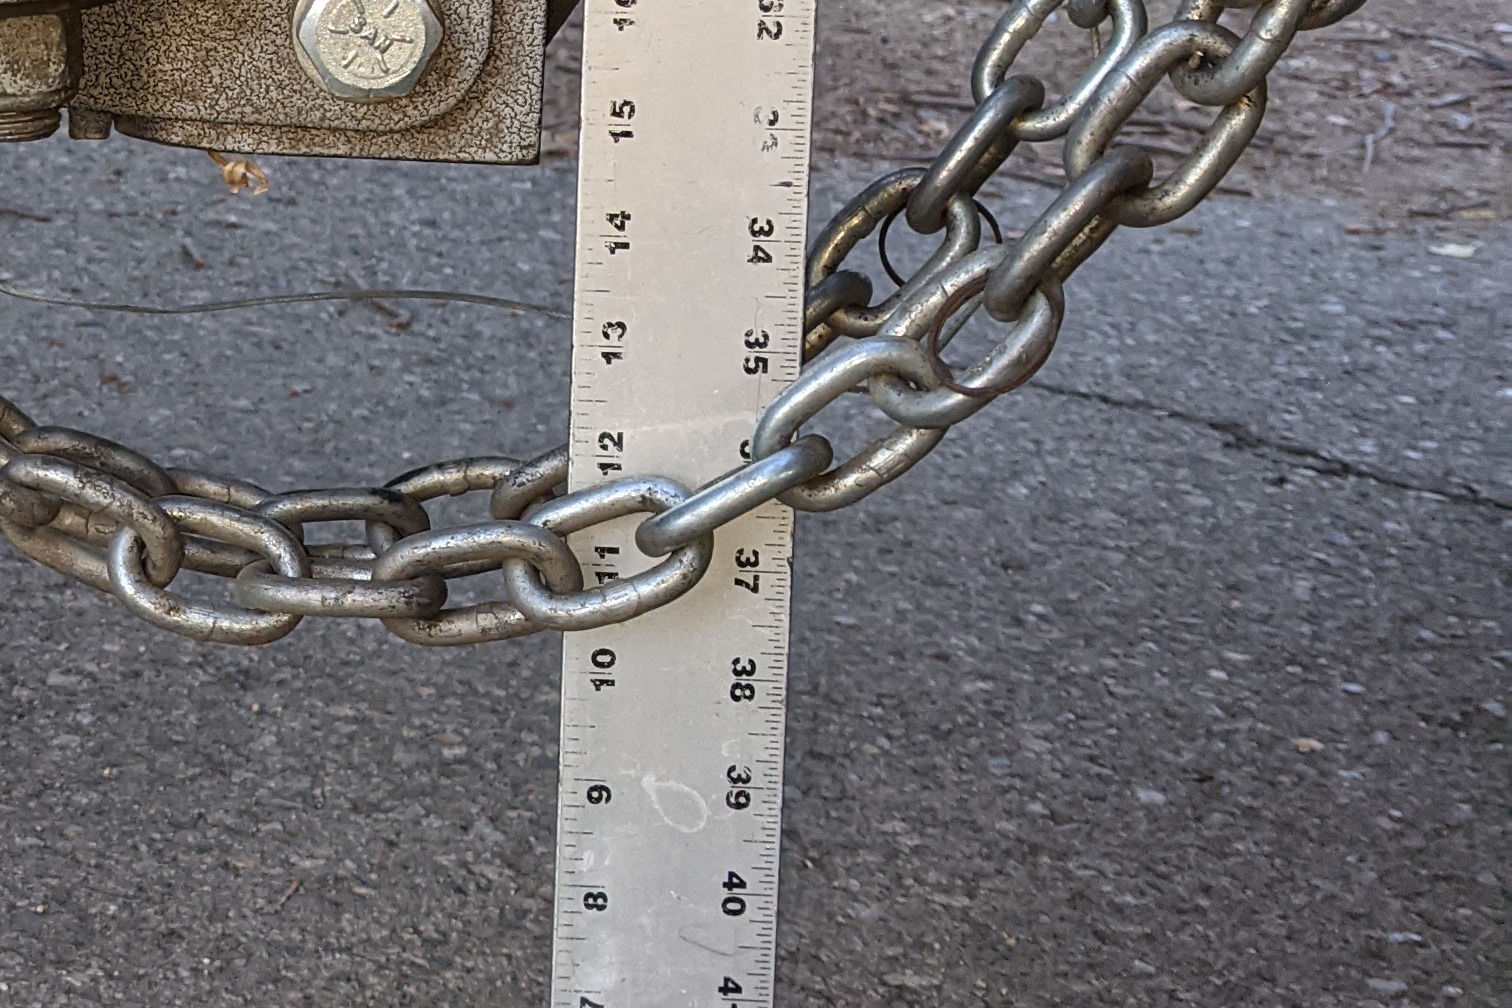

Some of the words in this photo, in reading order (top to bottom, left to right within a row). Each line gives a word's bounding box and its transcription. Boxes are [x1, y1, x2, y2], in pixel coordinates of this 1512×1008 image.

[608, 100, 636, 142] 15
[604, 211, 631, 253] 14
[747, 217, 774, 264] 34
[600, 320, 627, 364] 13
[742, 329, 770, 374] 35
[596, 431, 623, 476] 12
[595, 546, 619, 584] 11
[734, 549, 760, 594] 37
[590, 648, 616, 690] 10
[729, 657, 756, 702] 38
[587, 785, 612, 804] 9
[726, 765, 752, 810] 39
[583, 891, 608, 911] 8
[721, 871, 746, 916] 40
[718, 977, 742, 1008] 4
